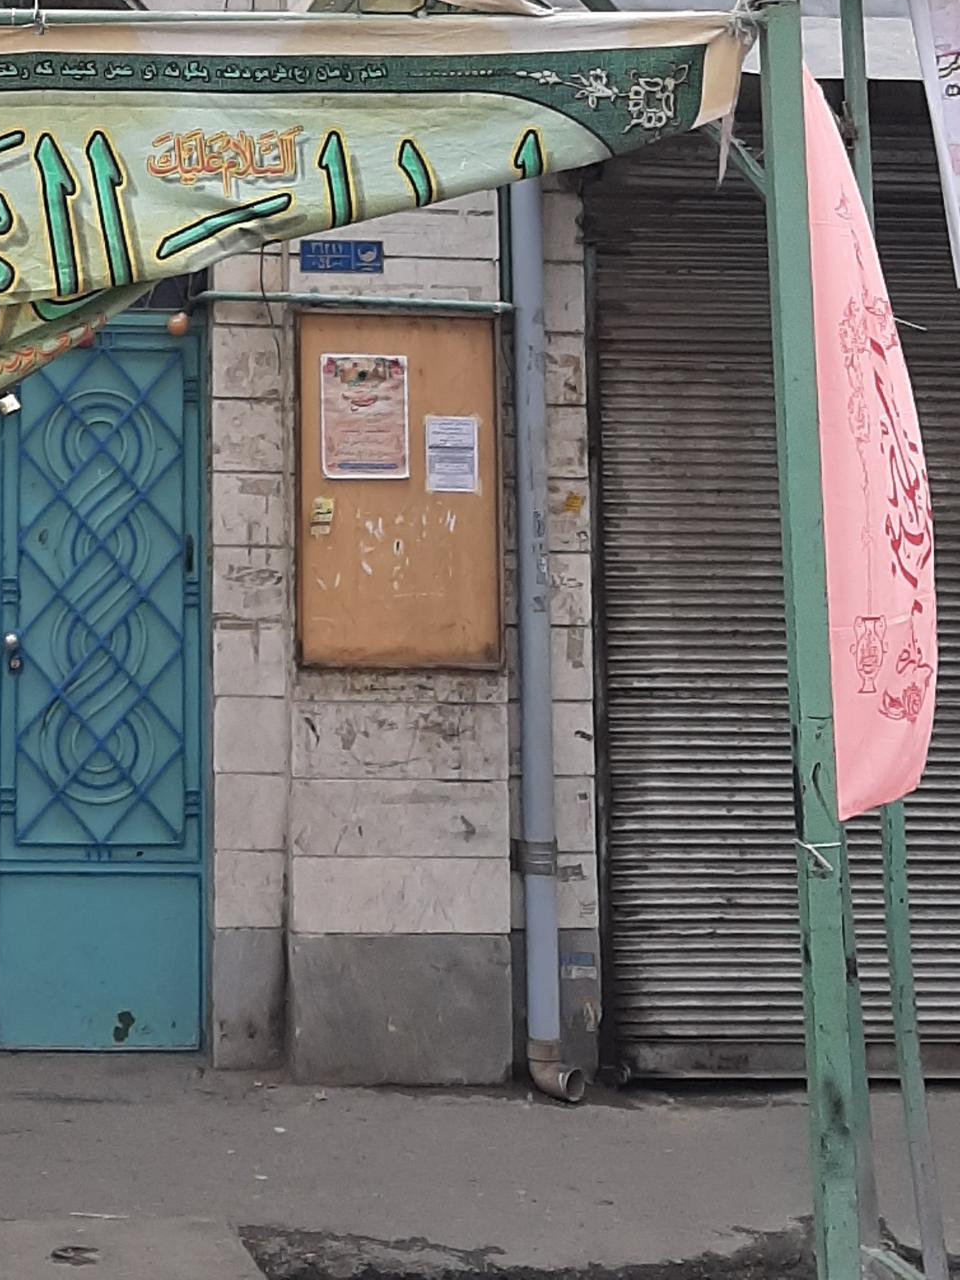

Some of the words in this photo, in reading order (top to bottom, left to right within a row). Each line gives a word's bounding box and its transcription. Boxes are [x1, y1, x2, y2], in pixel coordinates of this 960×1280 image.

[34, 58, 55, 76] که
[60, 59, 98, 81] کنید
[315, 63, 353, 82] زمان
[360, 63, 388, 84] امام
